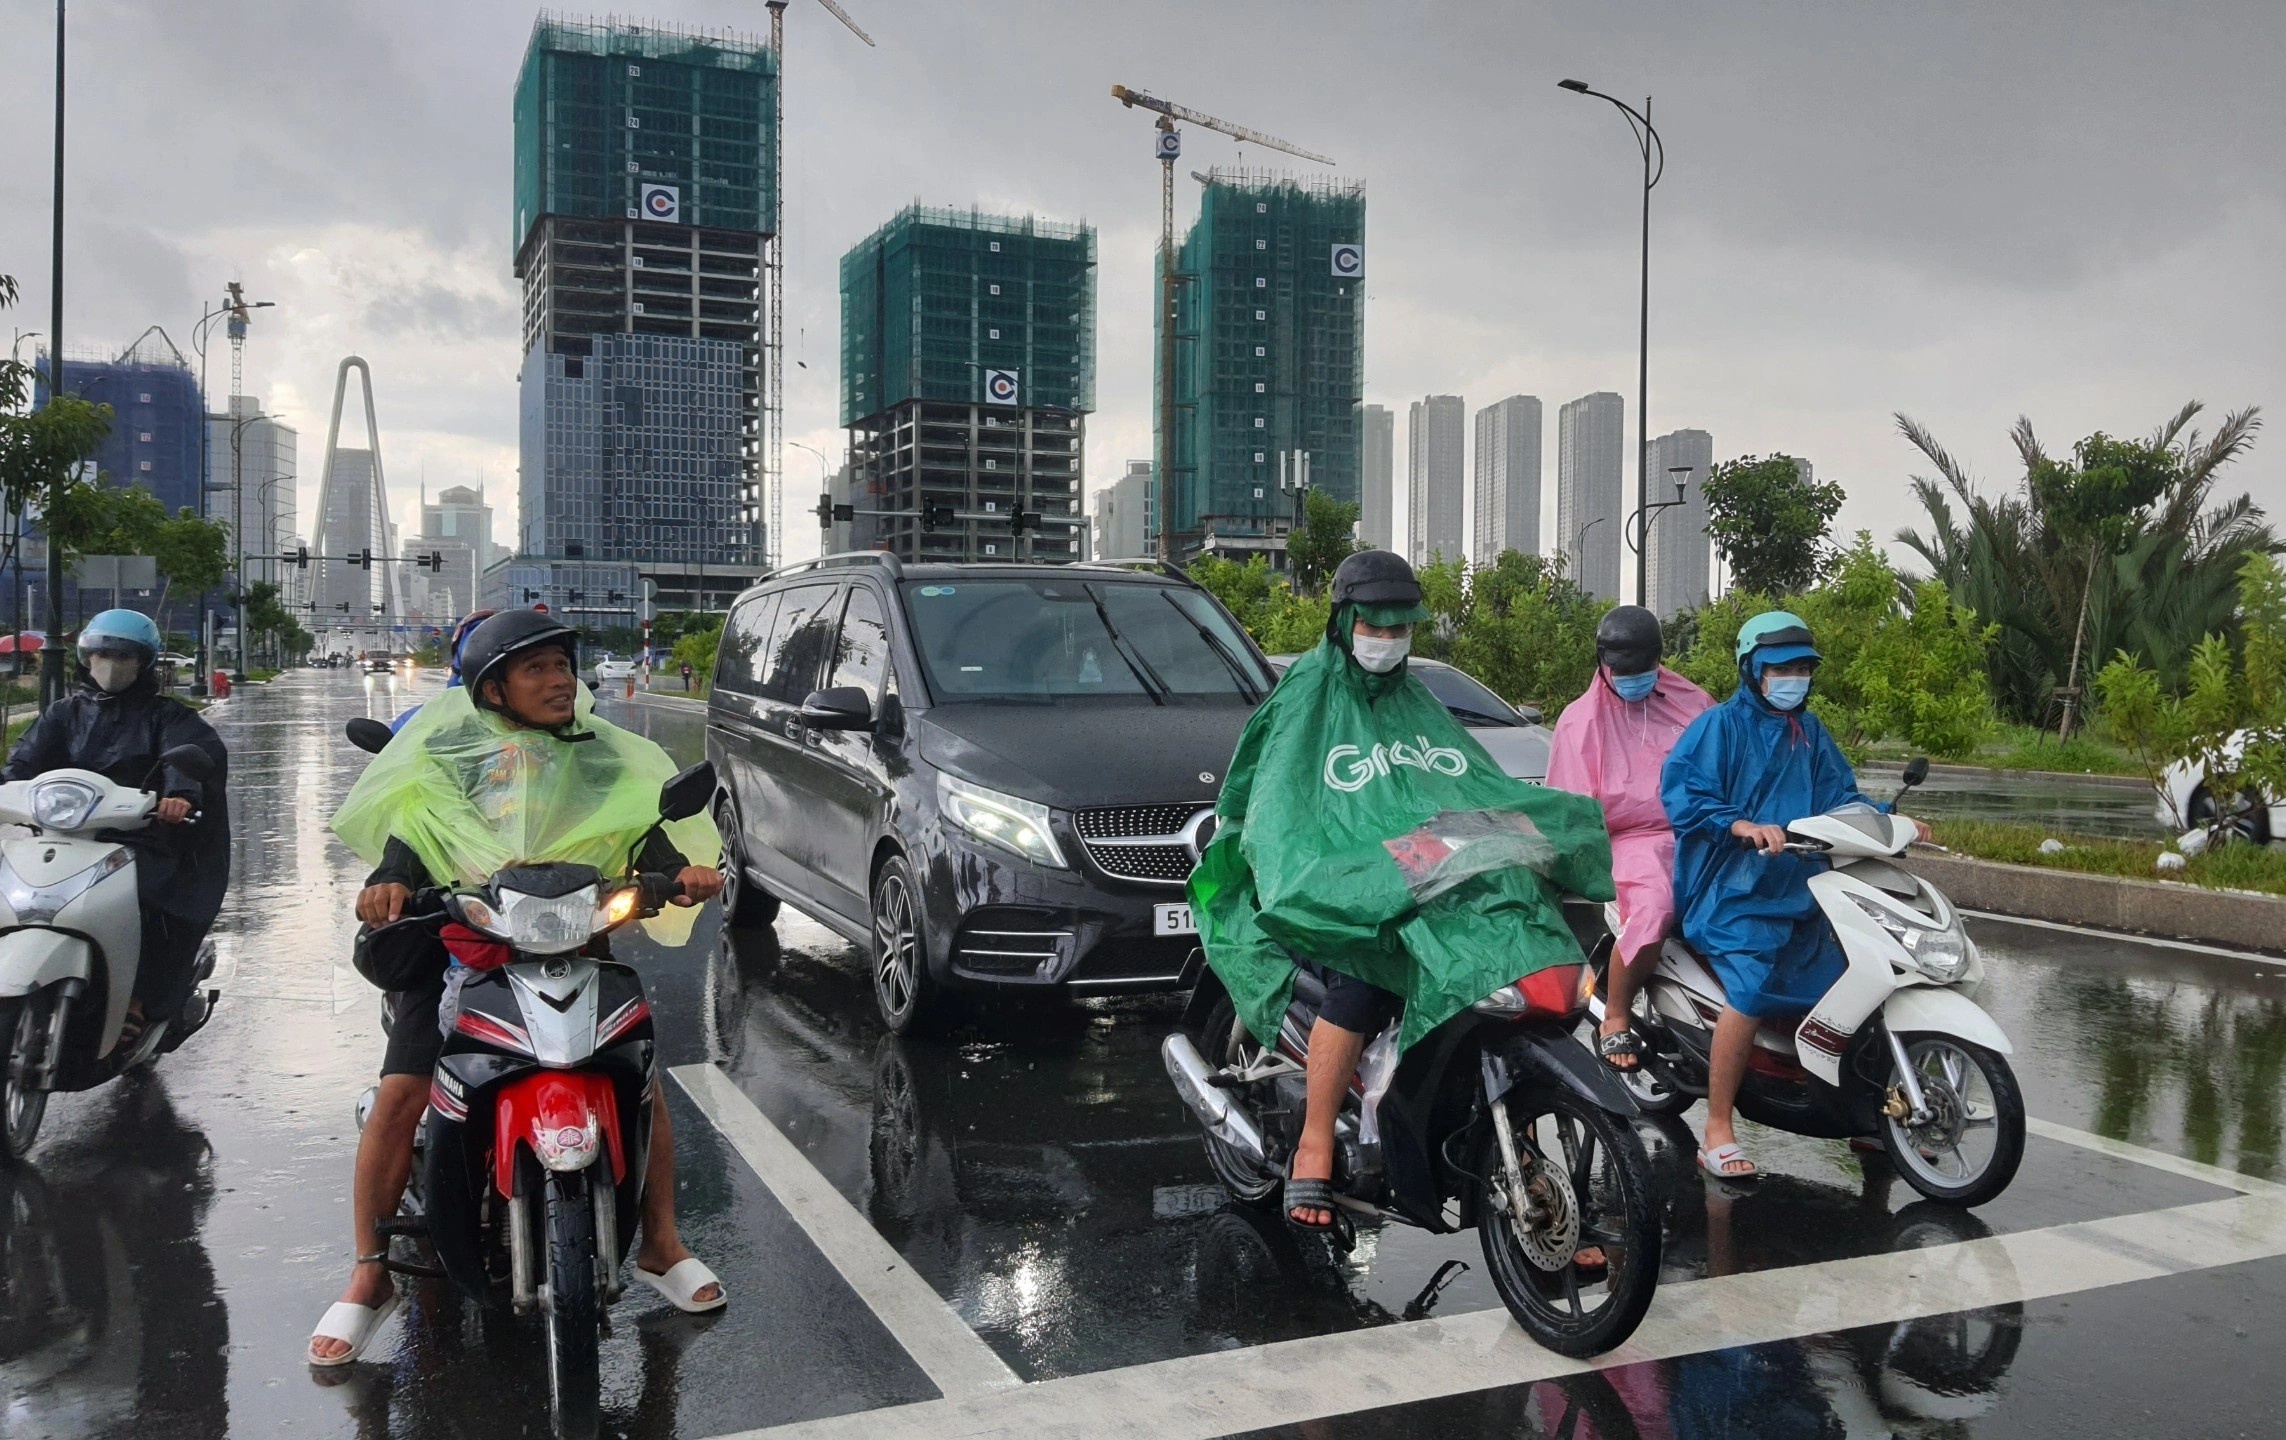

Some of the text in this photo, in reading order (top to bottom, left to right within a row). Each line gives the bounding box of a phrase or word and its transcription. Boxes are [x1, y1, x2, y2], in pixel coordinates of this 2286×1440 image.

[629, 117, 639, 127] 24
[629, 162, 638, 172] 22
[986, 460, 995, 469] 10
[1323, 735, 1468, 792] Grab
[437, 1065, 464, 1099] YAMAHA
